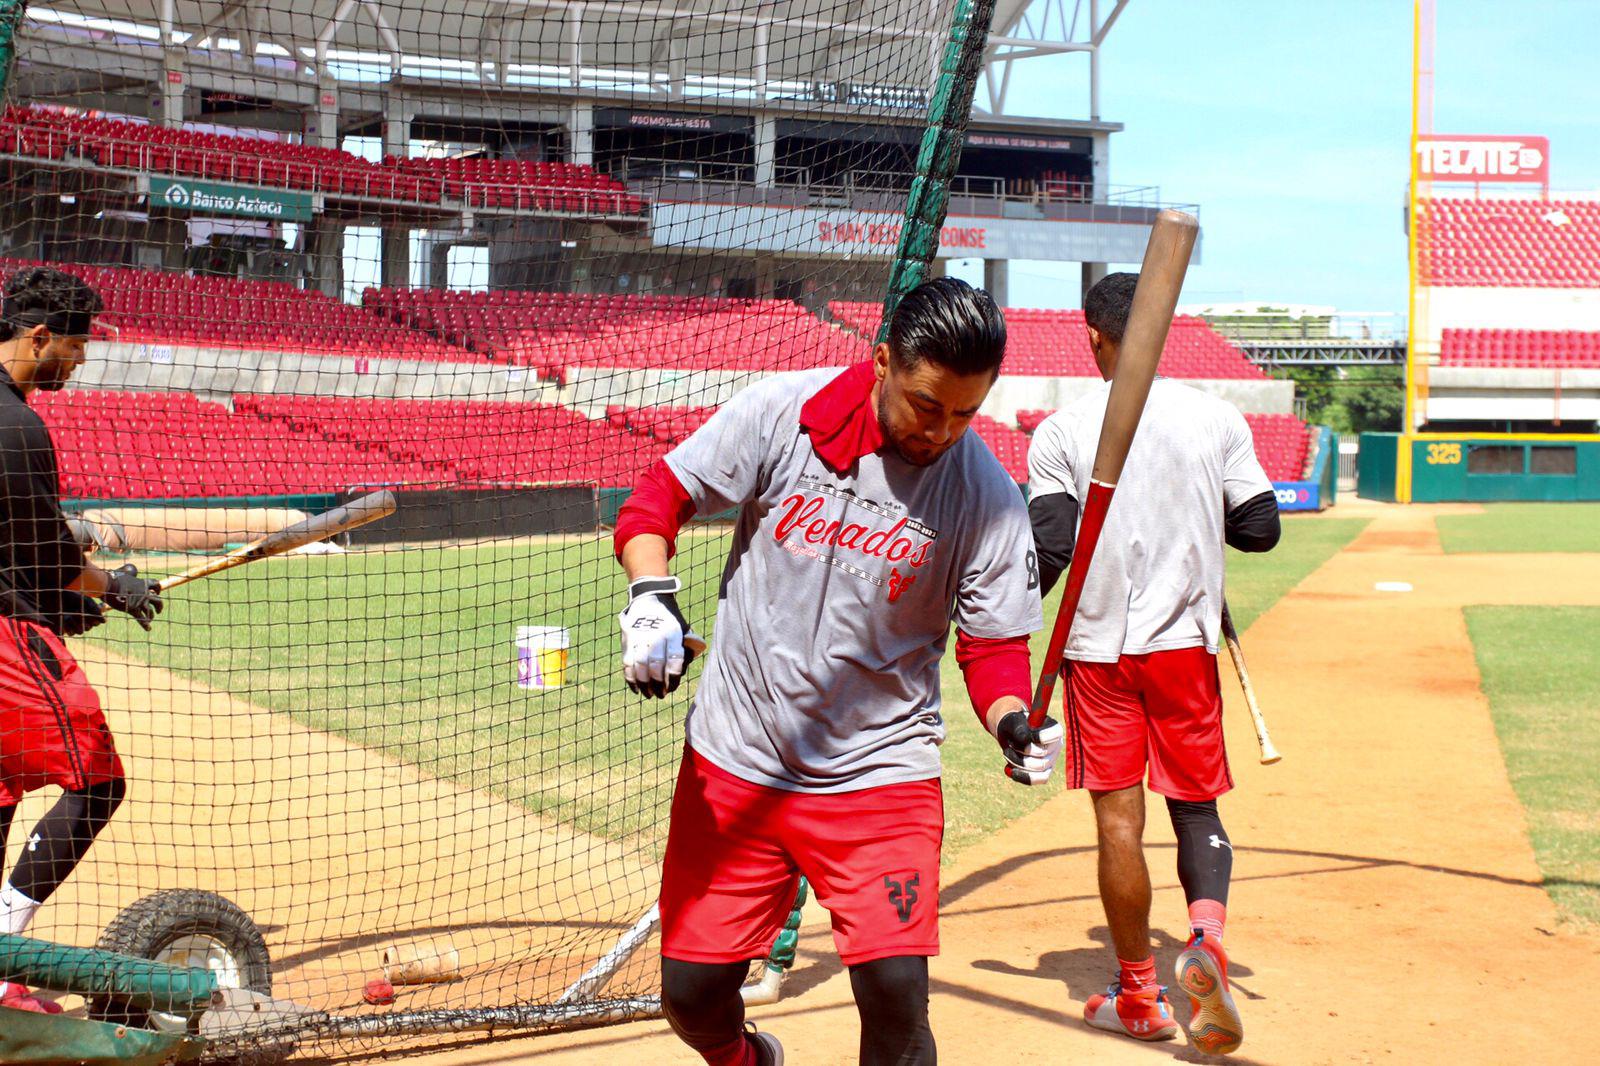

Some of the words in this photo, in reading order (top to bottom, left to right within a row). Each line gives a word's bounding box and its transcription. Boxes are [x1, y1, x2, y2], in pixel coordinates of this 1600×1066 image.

[1416, 141, 1524, 175] TECATE
[192, 190, 234, 210] Banco
[236, 195, 283, 215] Azteca
[818, 222, 833, 242] SI
[940, 227, 987, 249] CONSE
[1427, 443, 1462, 465] 325
[774, 493, 934, 568] Venados
